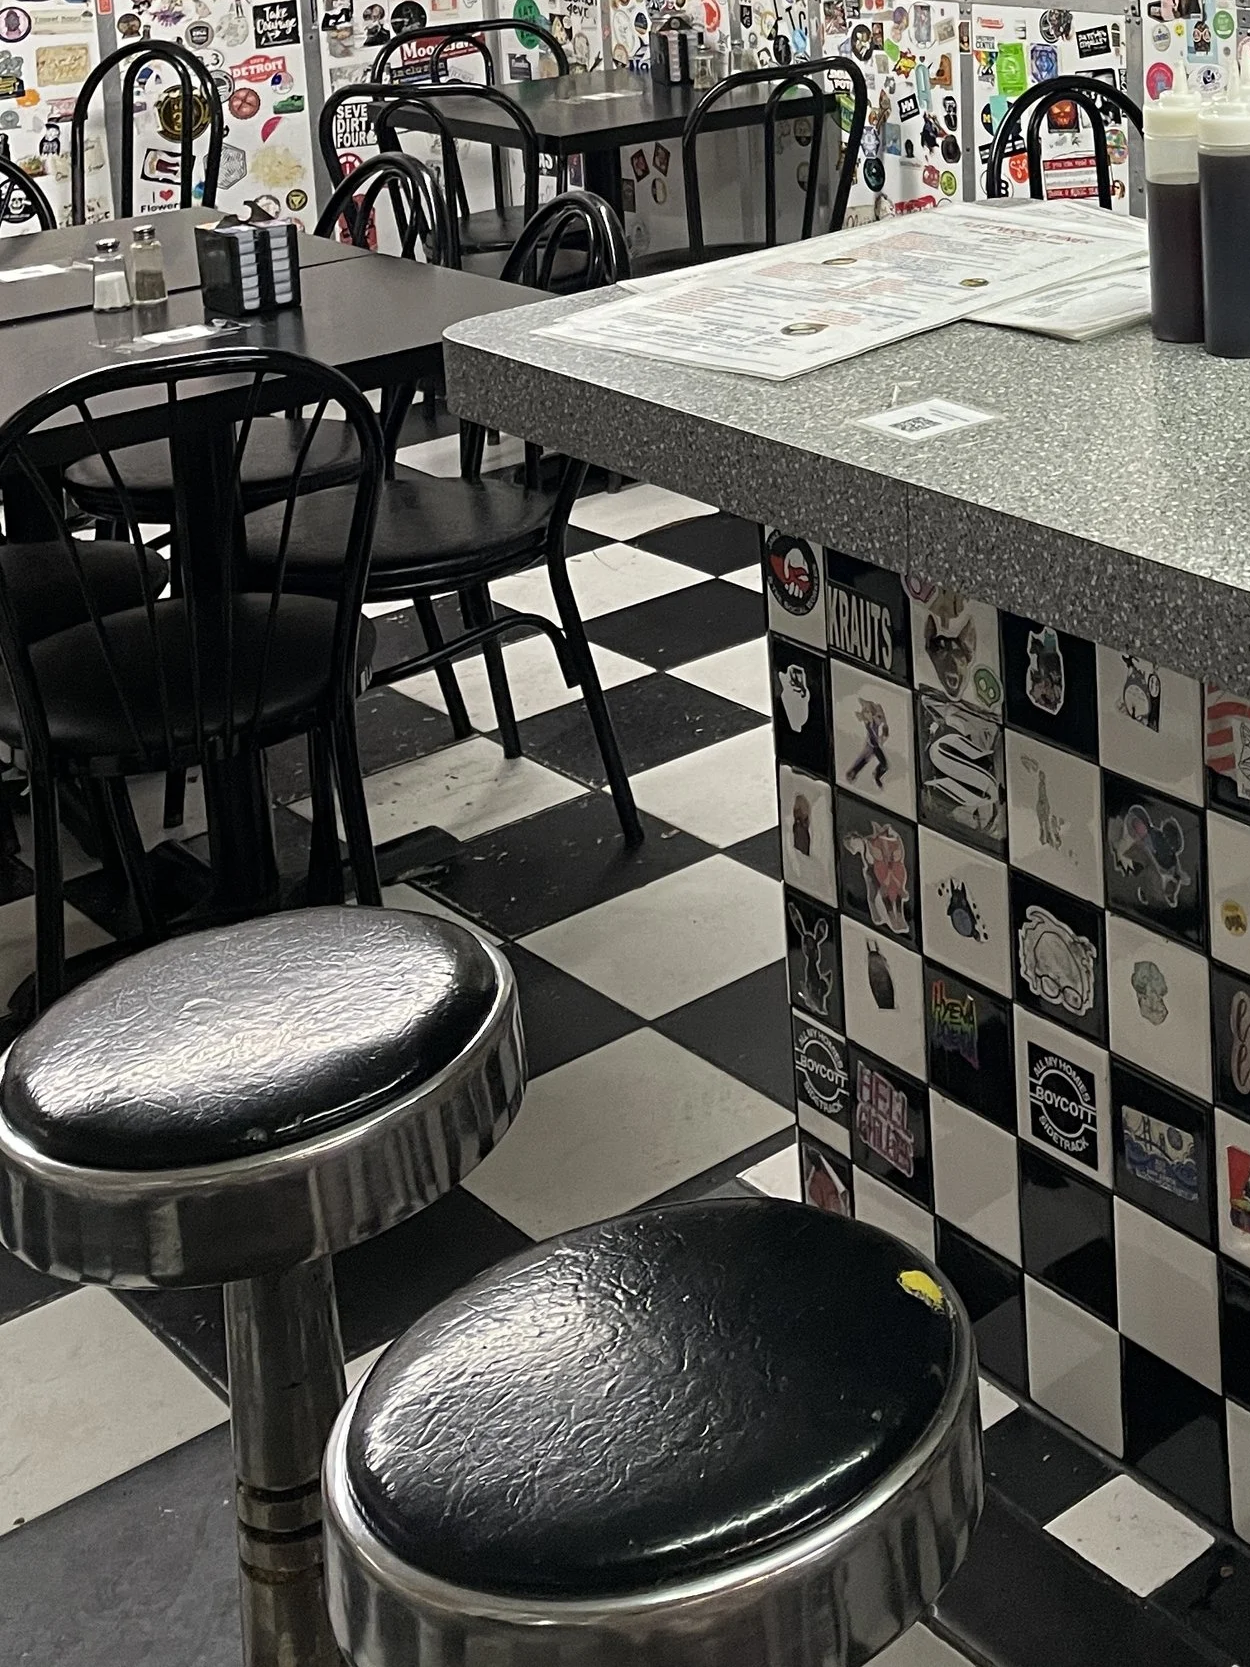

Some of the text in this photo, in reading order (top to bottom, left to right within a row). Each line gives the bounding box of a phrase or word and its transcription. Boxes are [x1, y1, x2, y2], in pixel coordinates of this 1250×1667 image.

[255, 15, 297, 33] Courage
[264, 5, 288, 19] Take
[232, 59, 286, 78] DETROIT
[901, 98, 915, 113] HH
[337, 132, 366, 148] FOUR
[828, 585, 893, 672] KRAUTS
[799, 1055, 847, 1088] BOYCOTT
[1032, 1054, 1092, 1105] ALL MY HOMIES
[803, 1081, 845, 1116] SIDETRACK
[1034, 1084, 1094, 1125] BOYCOTT
[1038, 1114, 1090, 1154] SIDETRACK
